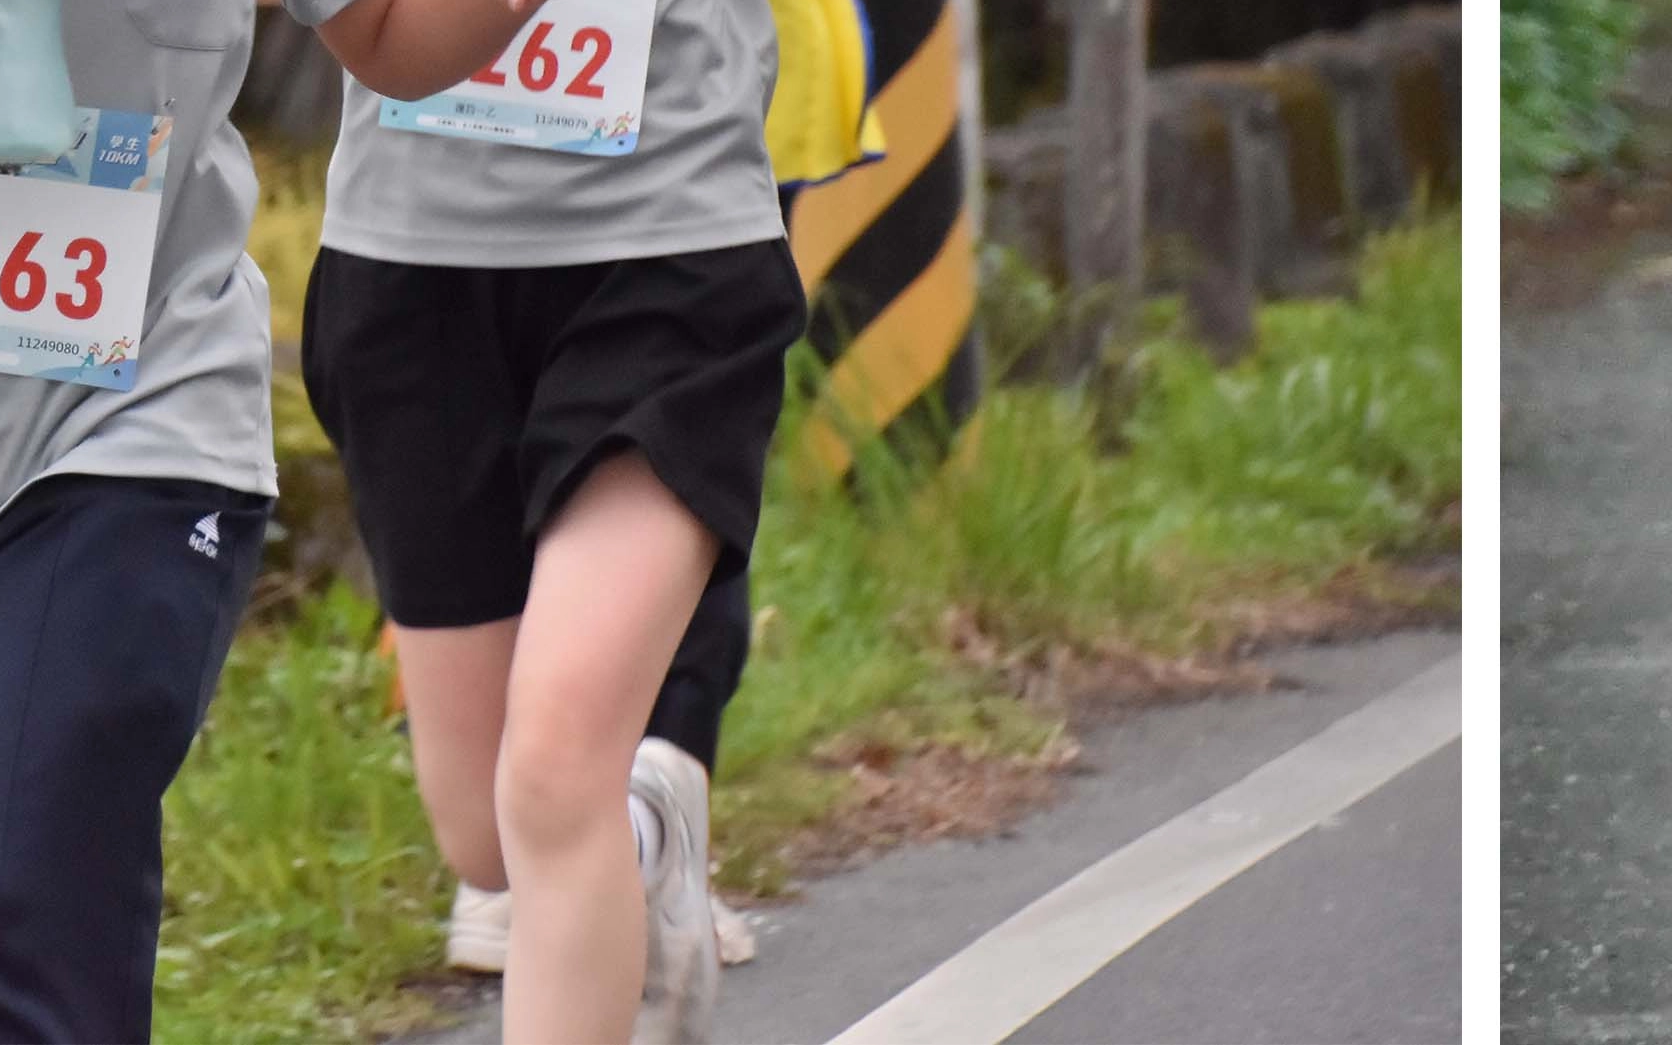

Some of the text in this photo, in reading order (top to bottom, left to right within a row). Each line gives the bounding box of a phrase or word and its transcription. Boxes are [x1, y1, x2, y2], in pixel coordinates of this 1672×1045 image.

[110, 135, 141, 151] 學生
[99, 149, 141, 165] 10KM
[17, 335, 80, 356] 11249080
